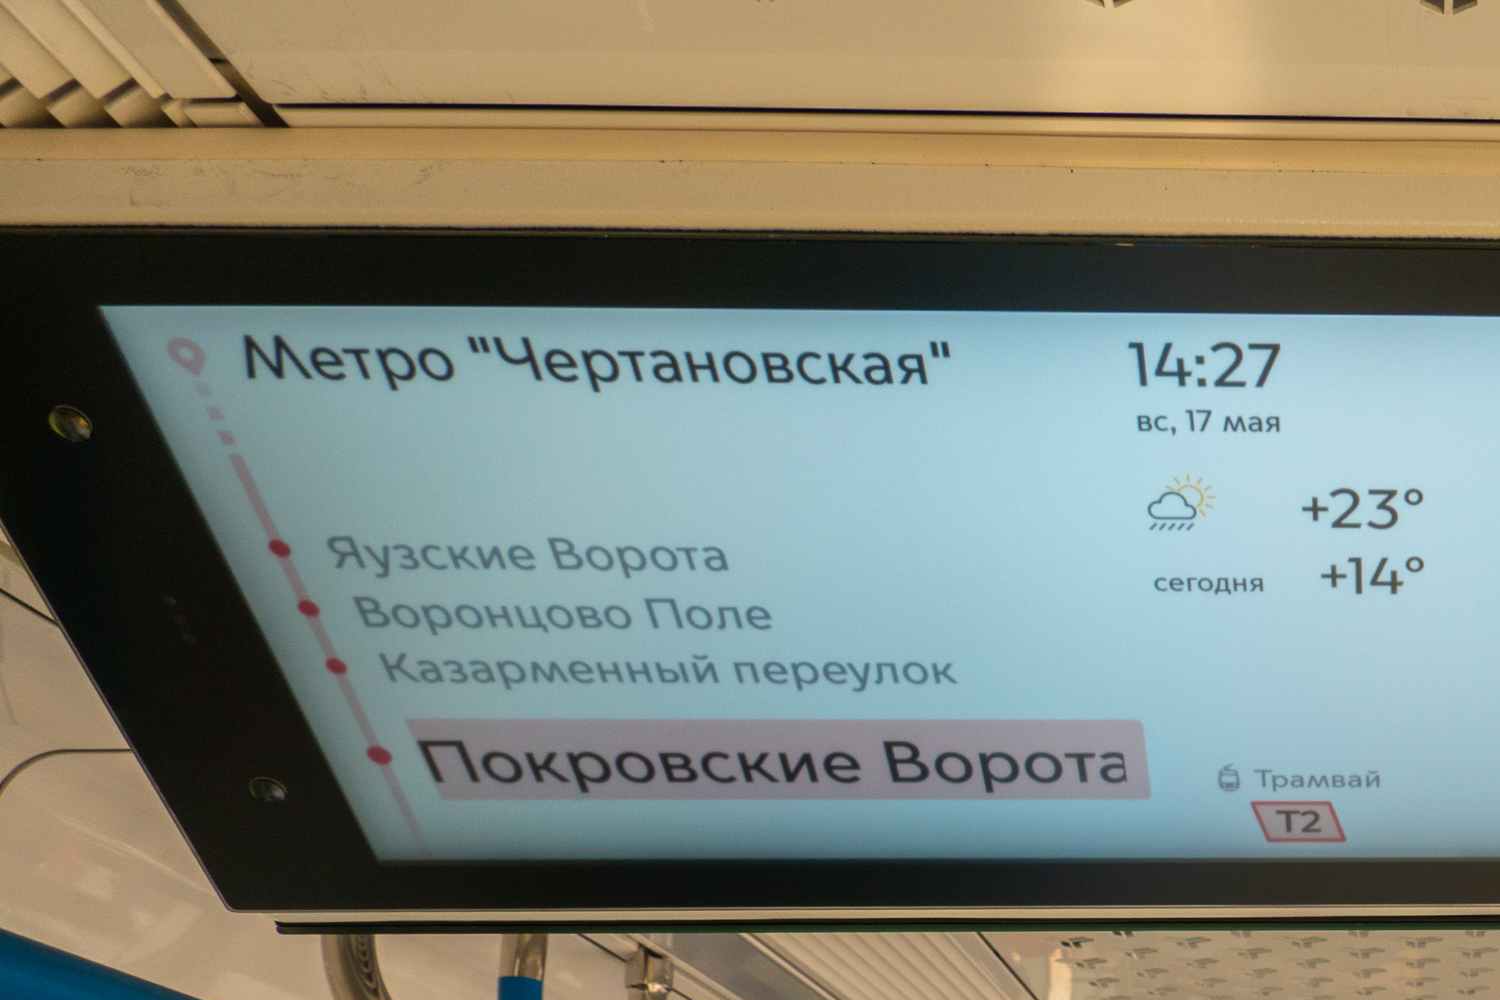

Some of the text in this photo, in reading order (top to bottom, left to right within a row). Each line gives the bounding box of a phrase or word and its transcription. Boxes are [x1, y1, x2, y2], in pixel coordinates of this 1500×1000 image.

[242, 335, 951, 393] Метро "Чертановская"
[1128, 341, 1282, 389] 14:27
[1136, 409, 1281, 435] вс, 17 мая
[1301, 487, 1425, 530] +23°
[326, 535, 729, 579] Яузские Ворота
[1153, 556, 1425, 595] сегодня +14°
[353, 596, 773, 635] Воронцово Поле
[378, 651, 959, 691] Казарменный переулок
[417, 738, 1128, 793] Покровские Ворота
[1254, 767, 1381, 792] Трамвай
[1276, 810, 1323, 834] Т2
